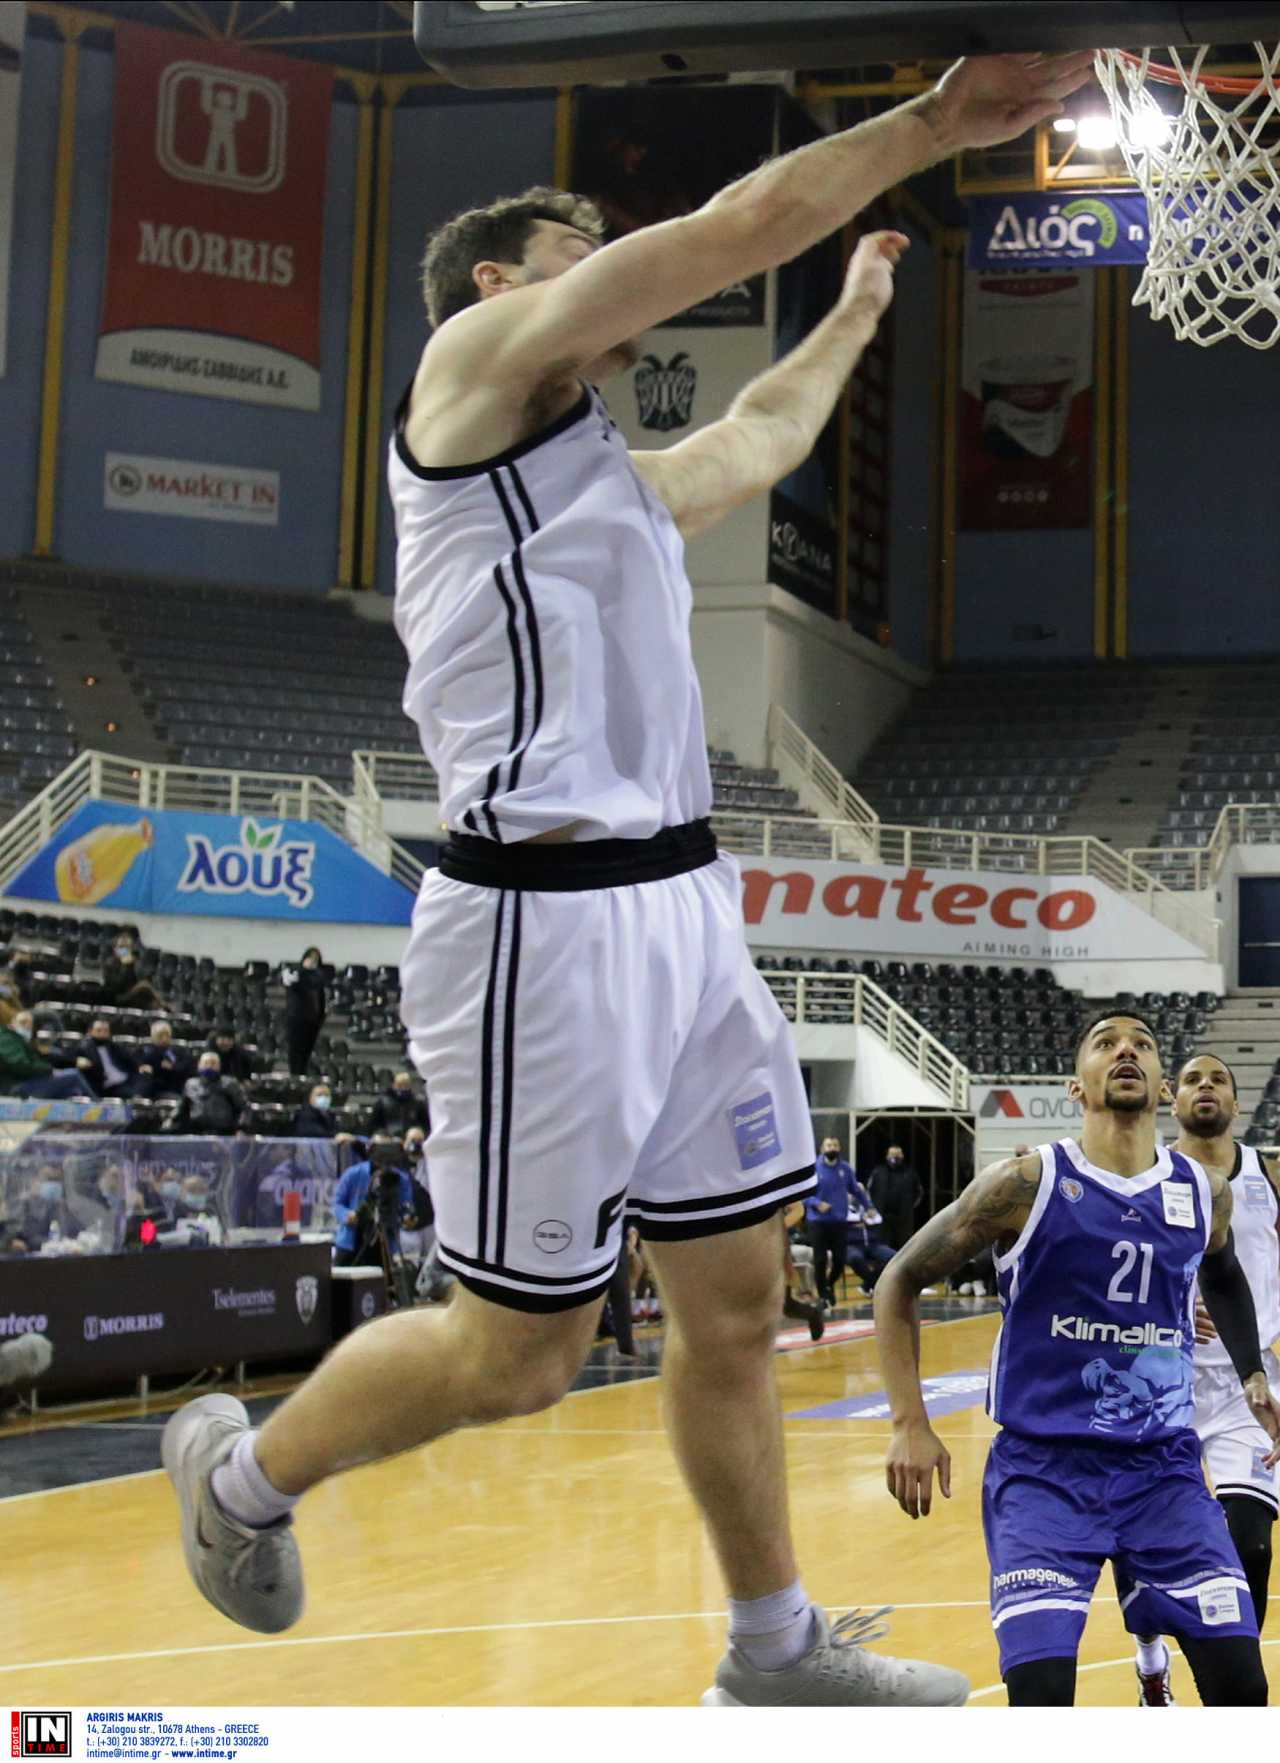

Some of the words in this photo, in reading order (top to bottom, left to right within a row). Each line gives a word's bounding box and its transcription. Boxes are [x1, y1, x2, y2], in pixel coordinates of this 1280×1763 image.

[137, 220, 294, 287] MORRIS
[147, 473, 241, 502] MARKET
[250, 482, 276, 504] IN
[962, 940, 1031, 956] AIMING
[1041, 943, 1089, 957] HIGH
[1107, 1240, 1154, 1304] 21
[99, 1312, 164, 1335] MORRIS
[1051, 1314, 1184, 1347] Klimallco
